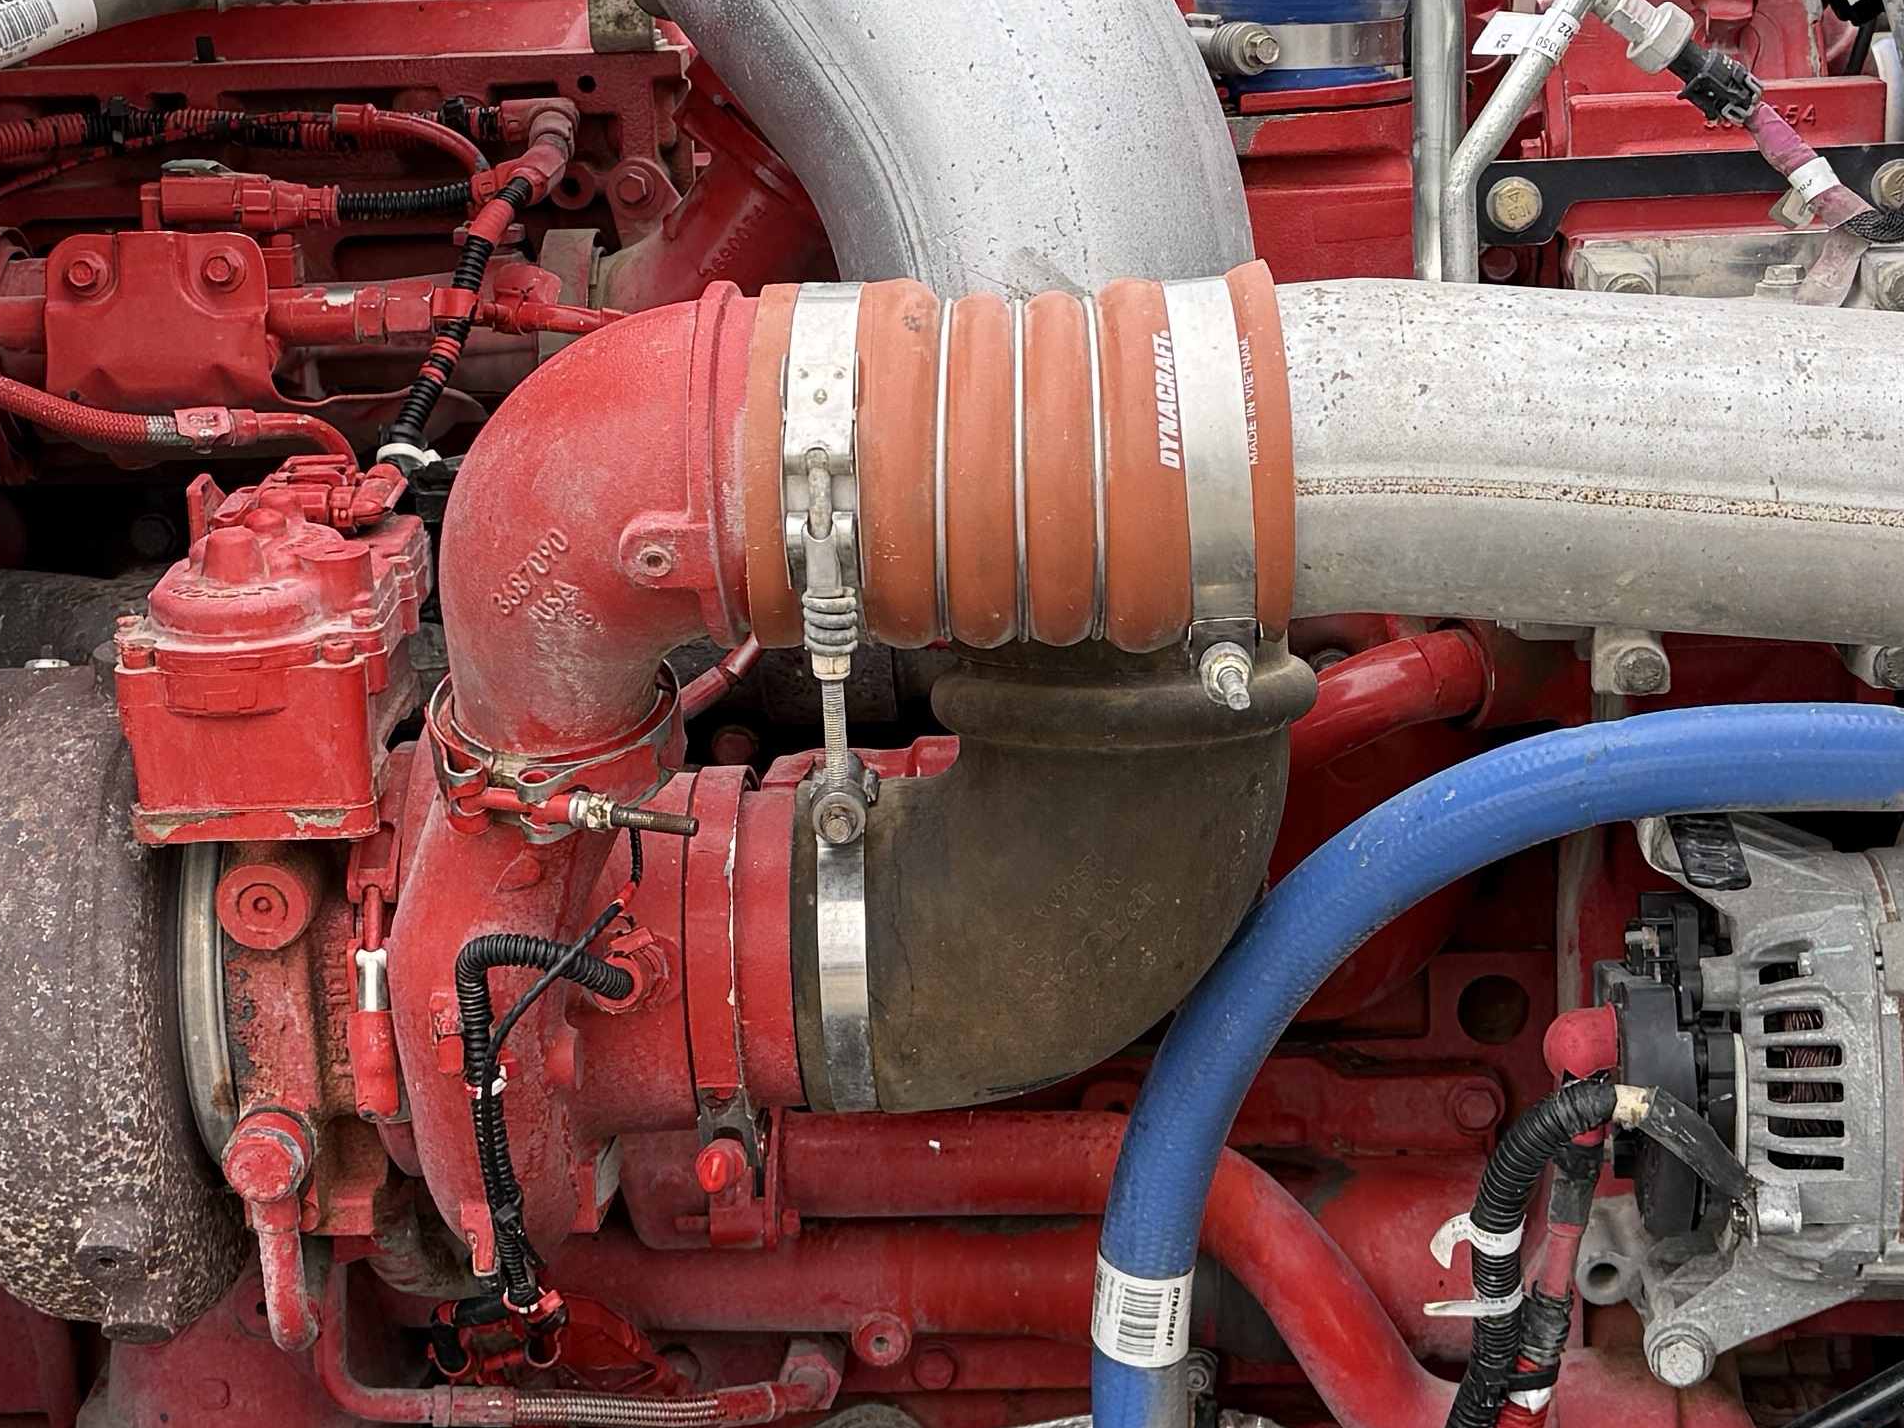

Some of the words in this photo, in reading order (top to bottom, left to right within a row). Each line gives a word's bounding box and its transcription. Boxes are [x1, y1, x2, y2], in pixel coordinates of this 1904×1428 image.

[1239, 338, 1255, 399] VIETNAM
[1152, 333, 1180, 469] DYNACRAFT
[1246, 402, 1256, 417] IN
[1247, 421, 1259, 465] MADE
[491, 527, 568, 615] 3687090
[528, 580, 580, 621] USA
[1165, 1287, 1180, 1347] DYNACRAFT
